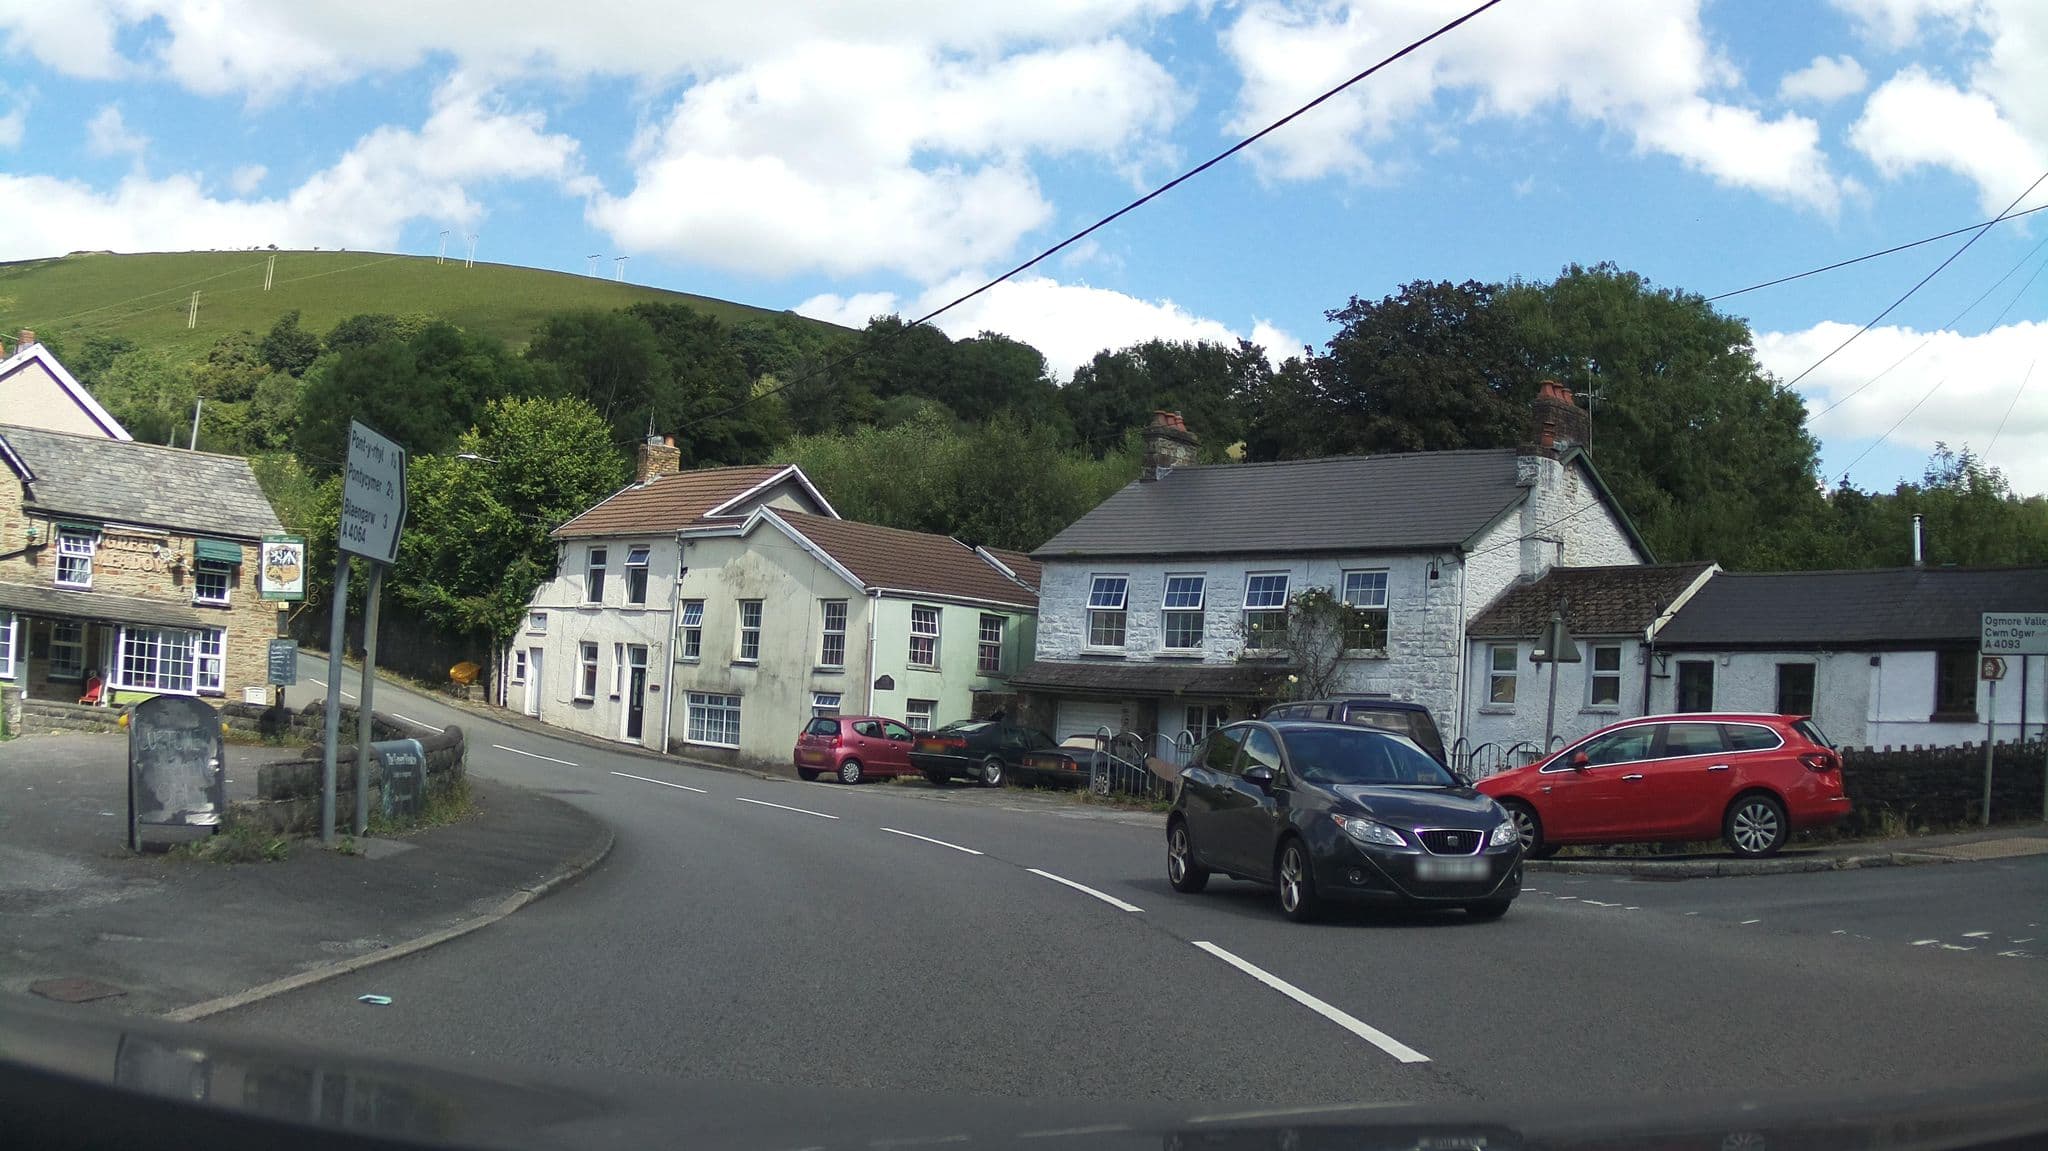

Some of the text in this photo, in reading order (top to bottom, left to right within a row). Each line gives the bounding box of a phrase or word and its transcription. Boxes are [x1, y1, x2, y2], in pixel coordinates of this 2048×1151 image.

[351, 430, 384, 464] Pont-y-rhyl
[348, 461, 382, 492] Pontycymer
[344, 498, 388, 529] Blaengarw 3
[342, 521, 367, 544] A 4064
[1985, 616, 2022, 627] Ogmore
[1985, 628, 2036, 638] Cwm Ogwr
[1985, 640, 2020, 649] A 4093
